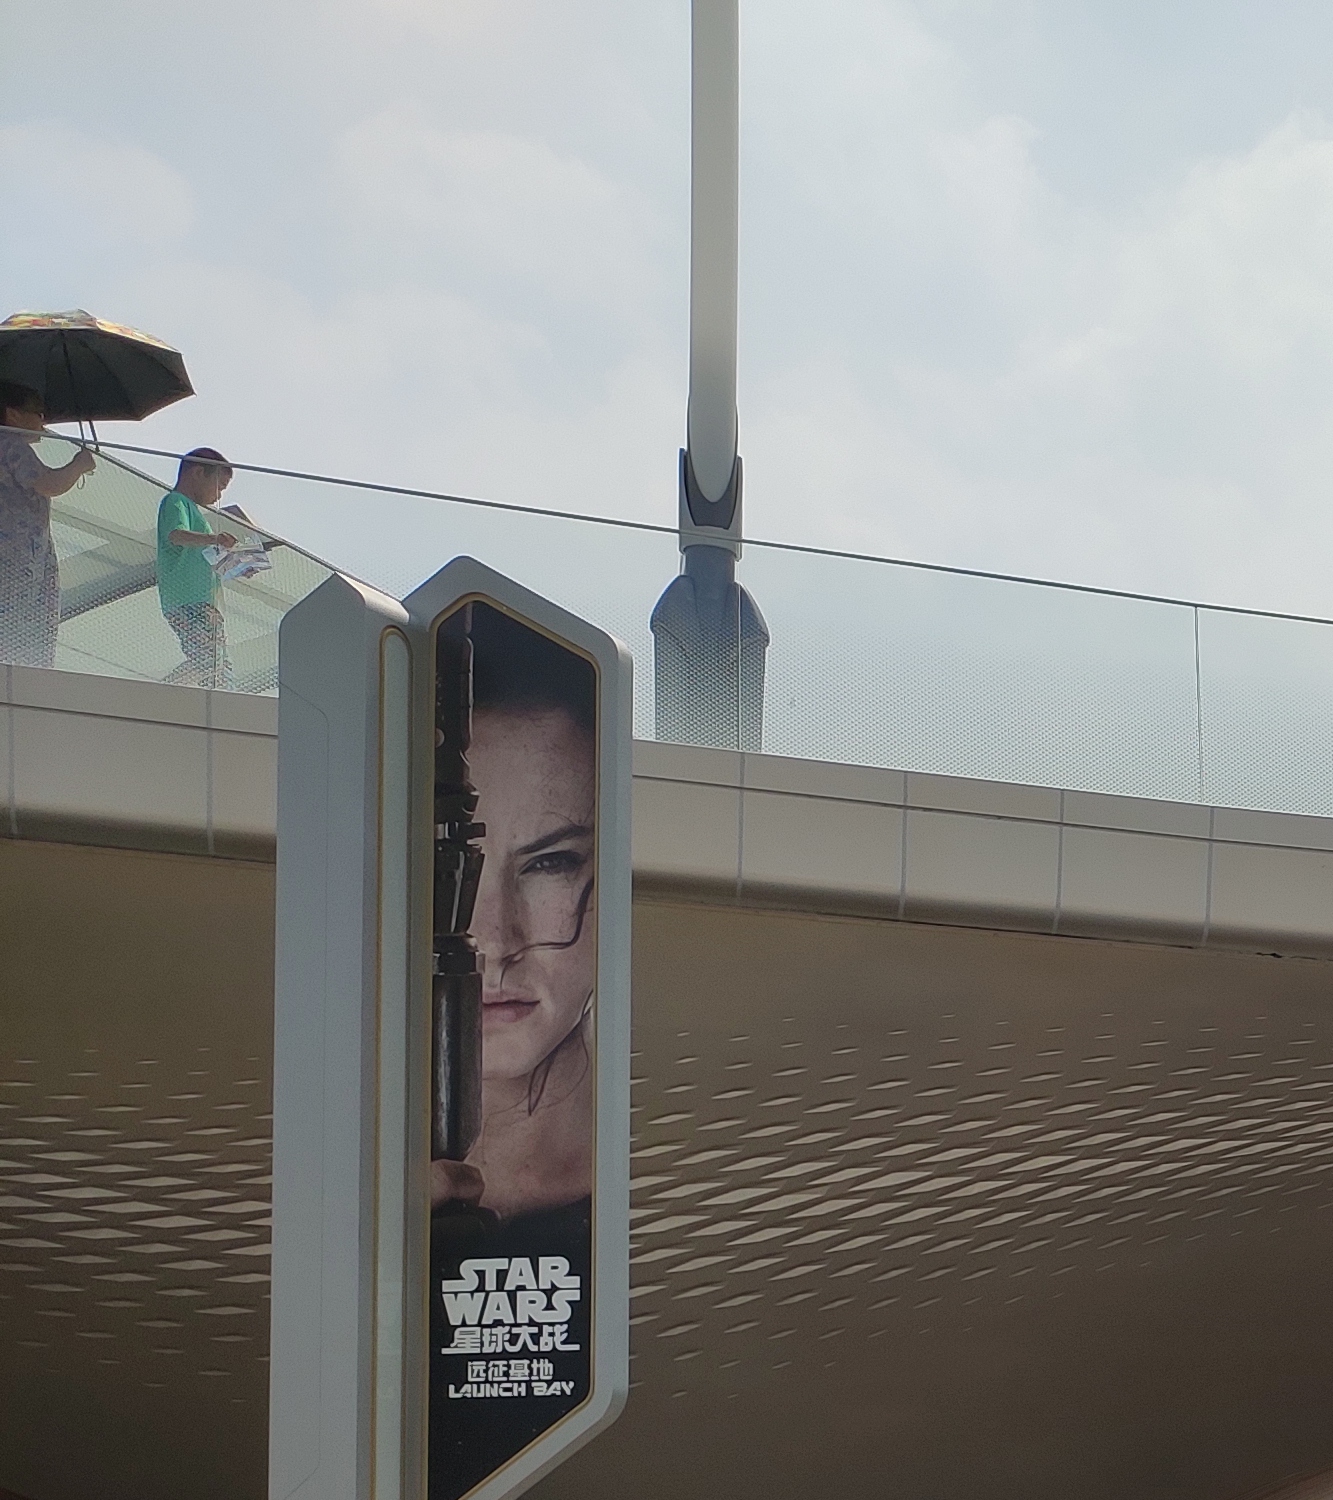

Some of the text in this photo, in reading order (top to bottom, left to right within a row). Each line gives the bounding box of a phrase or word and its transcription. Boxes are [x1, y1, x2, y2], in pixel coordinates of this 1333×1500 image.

[442, 1256, 581, 1292] STAR
[442, 1289, 581, 1325] WARS
[441, 1324, 580, 1354] 星球大战
[467, 1358, 554, 1382] 远征基地
[448, 1381, 575, 1398] LAUNCH BAY
